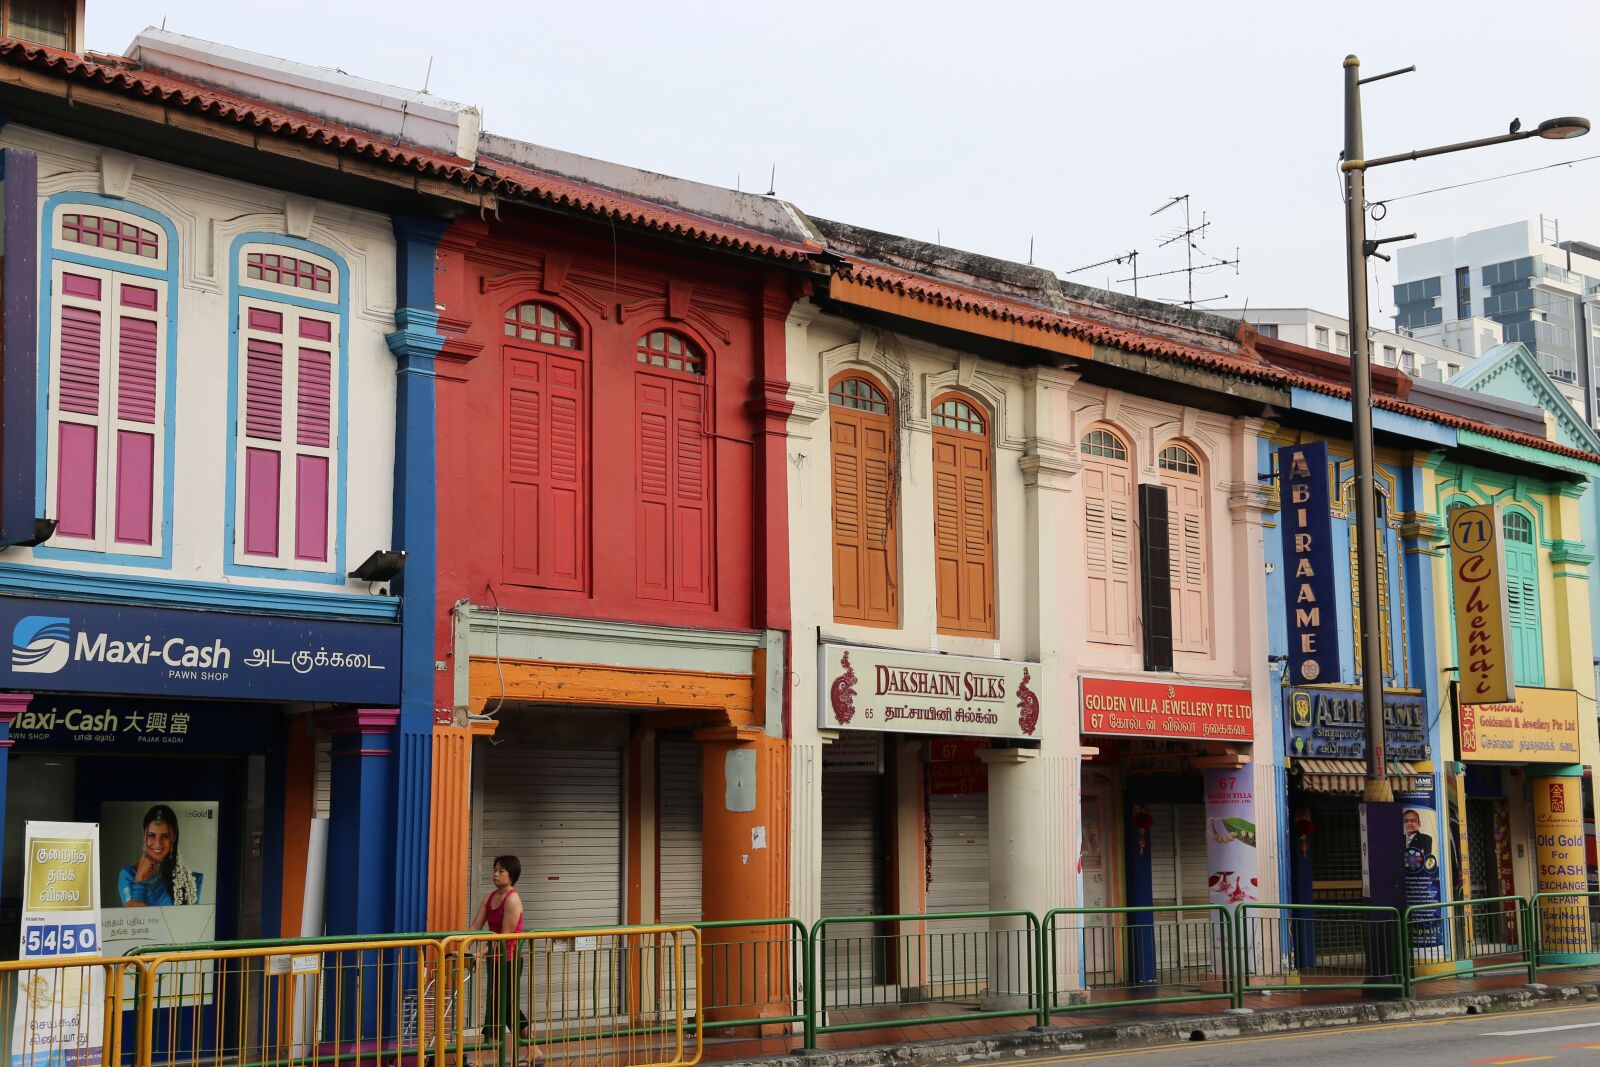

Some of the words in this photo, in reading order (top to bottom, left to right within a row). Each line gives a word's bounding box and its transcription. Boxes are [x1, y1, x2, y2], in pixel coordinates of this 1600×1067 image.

[1458, 519, 1487, 545] 71
[1289, 451, 1320, 654] ABIRAAME
[1458, 555, 1495, 694] Chennai
[74, 631, 231, 669] Maxi-Cash
[243, 646, 386, 674] அடகுக்கடை
[168, 669, 197, 680] PAWN
[200, 671, 230, 681] SHOP
[875, 665, 961, 696] DAKSHAINI
[964, 671, 1006, 701] SILKS
[864, 708, 874, 719] 65
[1085, 694, 1127, 712] GOLDEN
[1129, 697, 1158, 714] VILLA
[1161, 699, 1213, 717] JEWELLERY
[1216, 703, 1233, 718] PTE
[1235, 705, 1252, 720] LTD
[122, 710, 190, 735] 大興當
[1091, 713, 1104, 728] 67
[1480, 715, 1512, 728] Goldsmith
[1514, 717, 1520, 728] &
[1522, 717, 1551, 732] Jewellery
[1552, 719, 1563, 730] Pte
[1564, 719, 1576, 731] Ltd
[28, 733, 50, 741] SHOP
[137, 735, 160, 743] PAJAK
[942, 743, 958, 759] 67
[1218, 776, 1237, 790] 67
[1536, 835, 1554, 847] Old
[1557, 835, 1583, 847] Gold
[1551, 850, 1569, 859] For
[1540, 864, 1584, 876] $CASH
[1539, 881, 1585, 891] EXCHANGE
[1547, 895, 1579, 905] REPAIR
[27, 928, 95, 952] 5450
